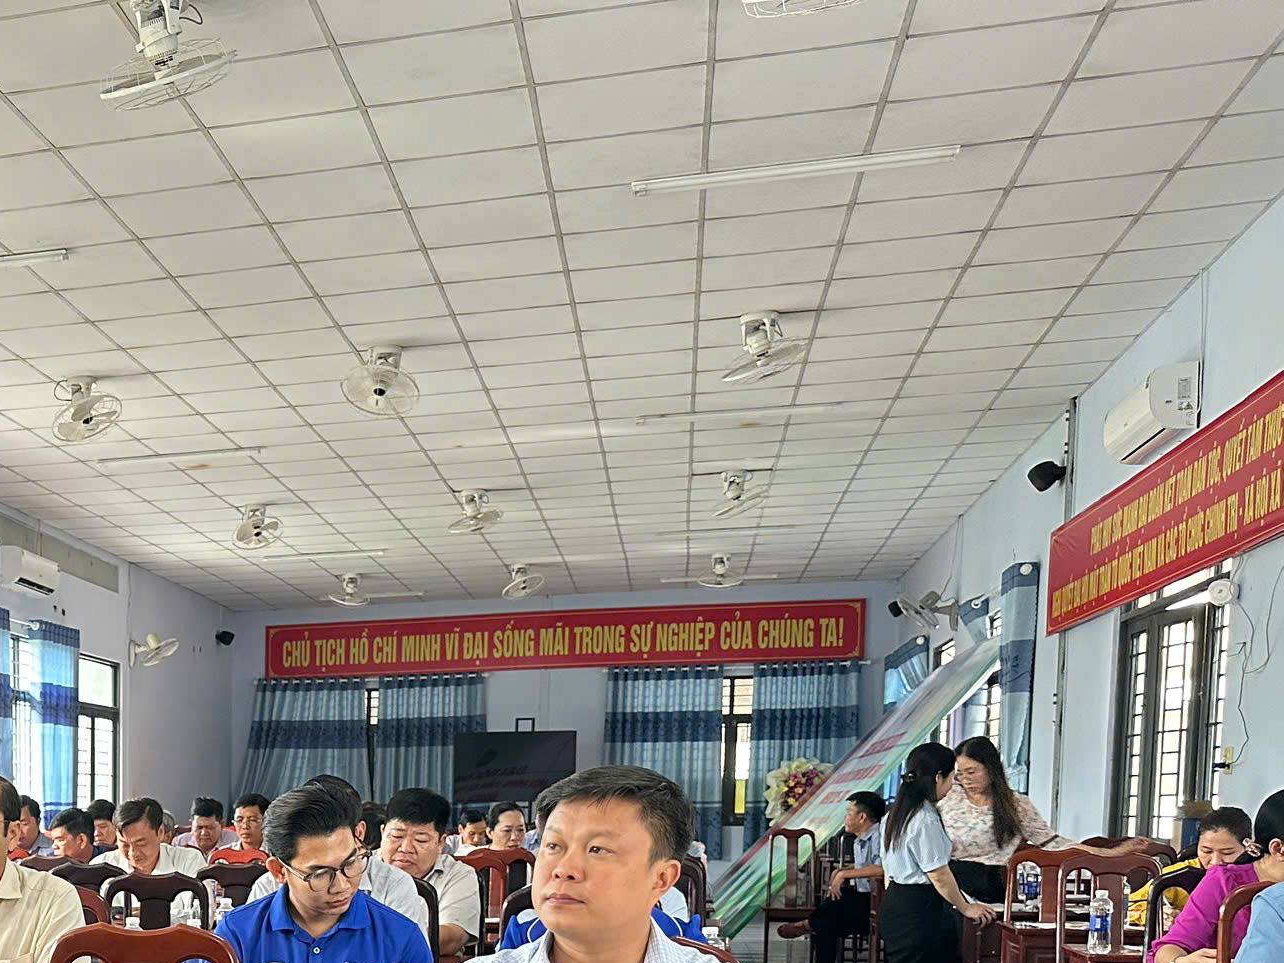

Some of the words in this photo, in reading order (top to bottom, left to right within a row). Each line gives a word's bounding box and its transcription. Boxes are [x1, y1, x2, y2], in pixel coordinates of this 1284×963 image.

[1222, 418, 1247, 482] QUYẾT
[282, 630, 310, 668] CHỦ
[314, 638, 345, 672] TỊCH
[349, 628, 369, 665] HỒ
[372, 630, 398, 664] CHÍ
[401, 634, 441, 662] MINH
[445, 627, 461, 660] VĨ
[463, 631, 488, 665] ĐẠI
[492, 620, 534, 658] SỐNG
[539, 622, 569, 656] MÃI
[574, 623, 625, 655] TRONG
[630, 621, 654, 659] SỰ
[656, 616, 715, 657] NGHIỆP
[720, 611, 753, 650] CỦA
[757, 613, 815, 649] CHÚNG
[819, 617, 845, 648] TA!
